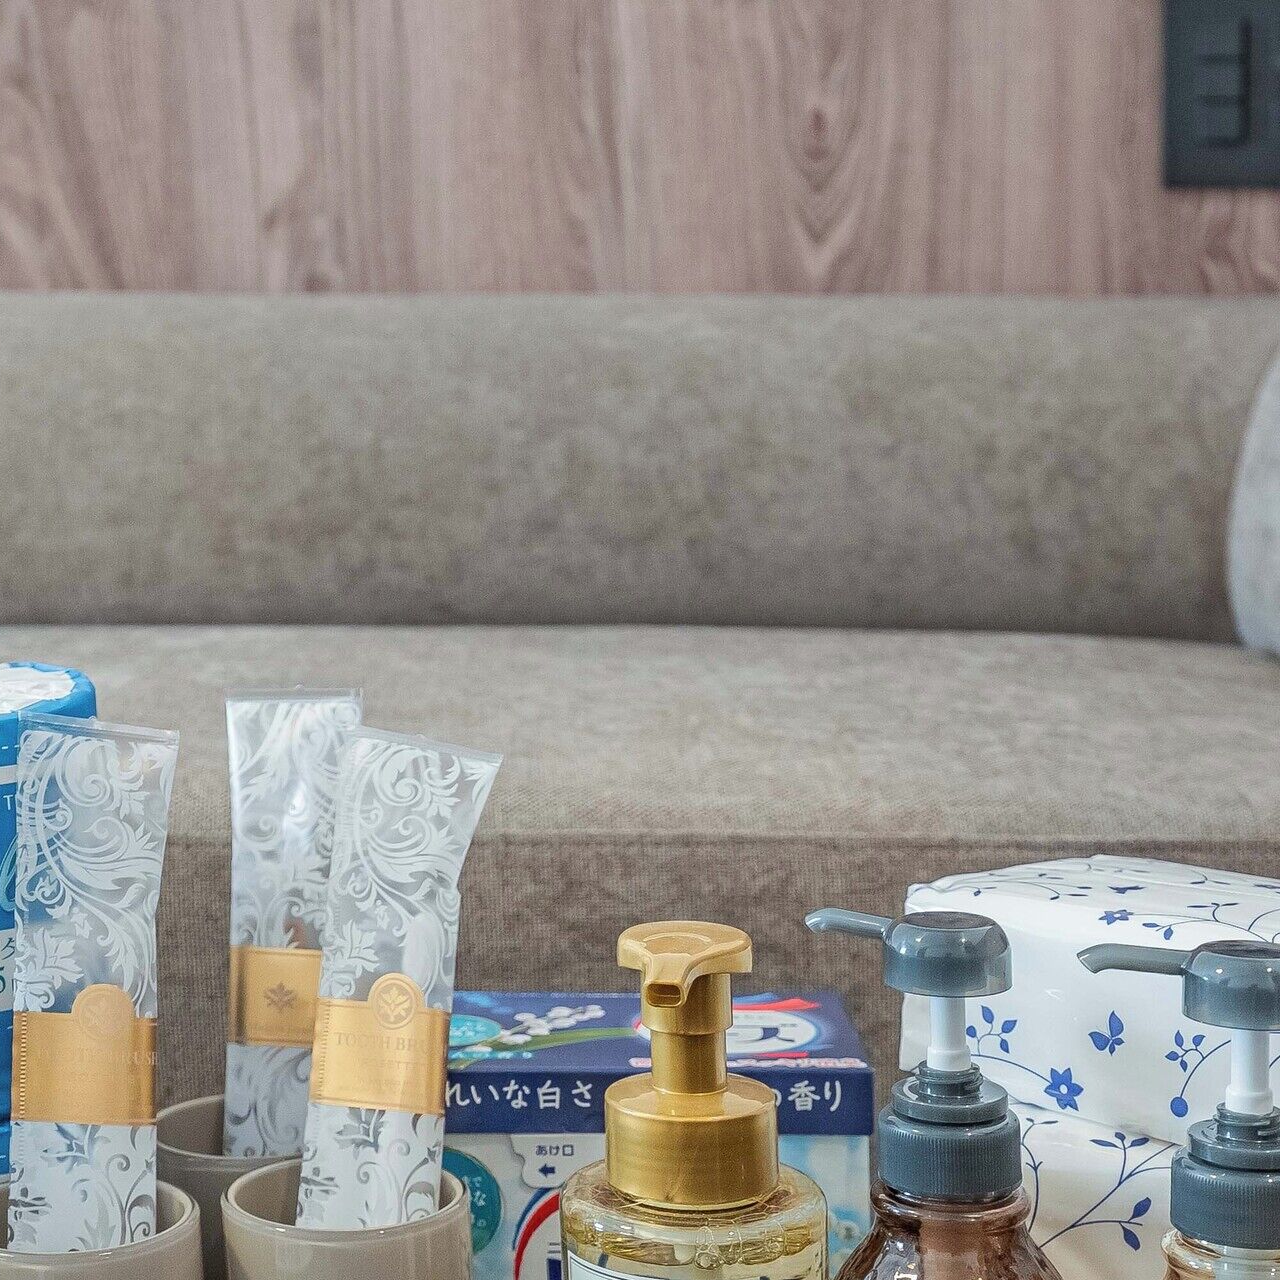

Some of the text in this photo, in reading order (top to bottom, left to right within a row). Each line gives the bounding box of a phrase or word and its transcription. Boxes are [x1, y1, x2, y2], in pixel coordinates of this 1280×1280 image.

[774, 1080, 843, 1112] 香り
[535, 1145, 575, 1157] あけ口
